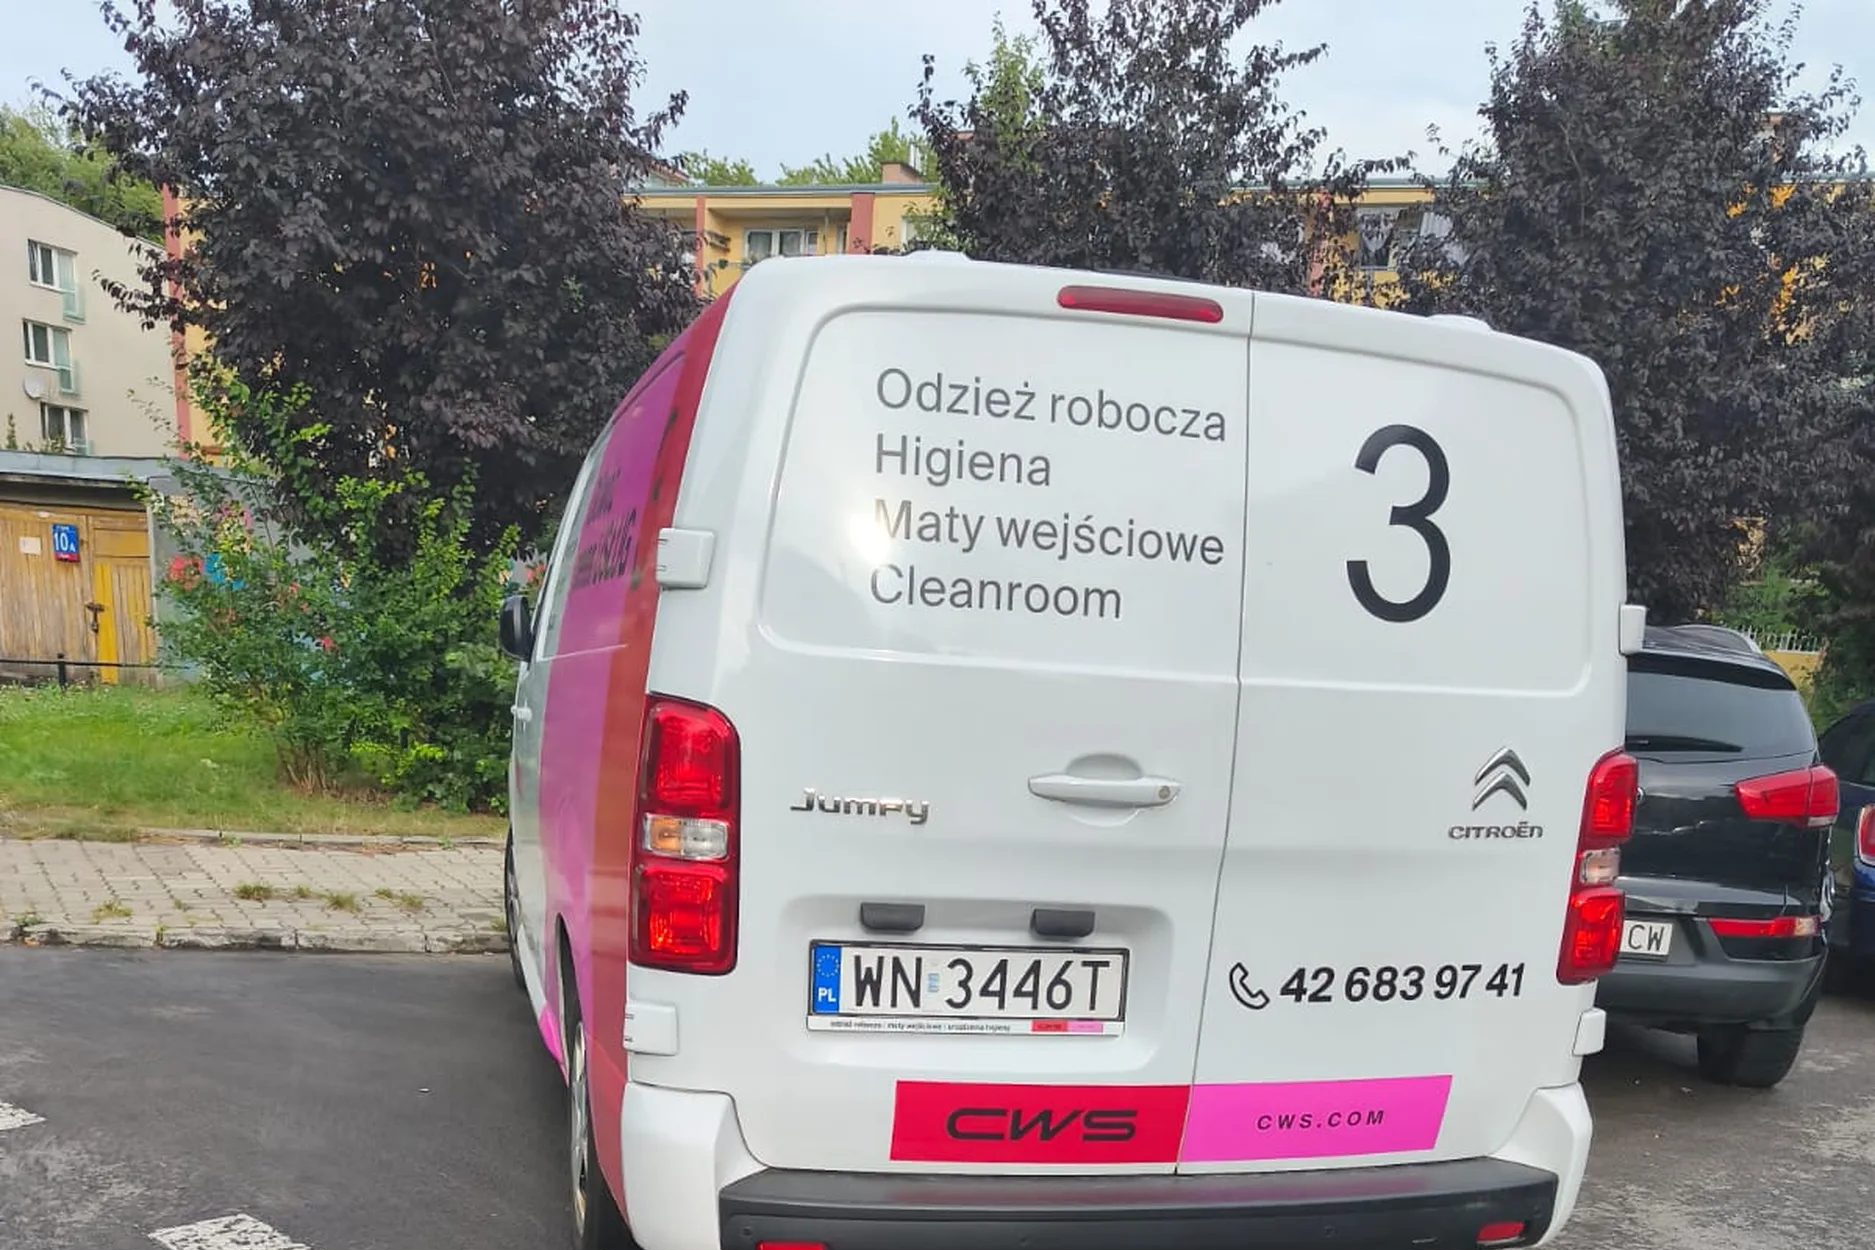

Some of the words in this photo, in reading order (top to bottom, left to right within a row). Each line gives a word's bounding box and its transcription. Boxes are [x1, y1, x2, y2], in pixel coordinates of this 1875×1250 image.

[876, 367, 1037, 421] Odzież
[1049, 388, 1227, 442] robocza
[874, 432, 1051, 487] Higiena
[873, 497, 985, 553] Maty
[995, 511, 1225, 566] wejściowe
[1346, 423, 1451, 623] 3
[869, 562, 1123, 619] Cleanroom
[789, 786, 931, 826] Jumpy
[1627, 924, 1665, 952] CW
[818, 986, 837, 1003] PL
[853, 954, 923, 1009] WN
[944, 957, 1112, 1012] 3446T
[1279, 966, 1335, 1003] 42
[1344, 965, 1426, 1002] 683
[945, 1107, 1139, 1142] CWS
[1255, 1108, 1386, 1132] CWS.COM
